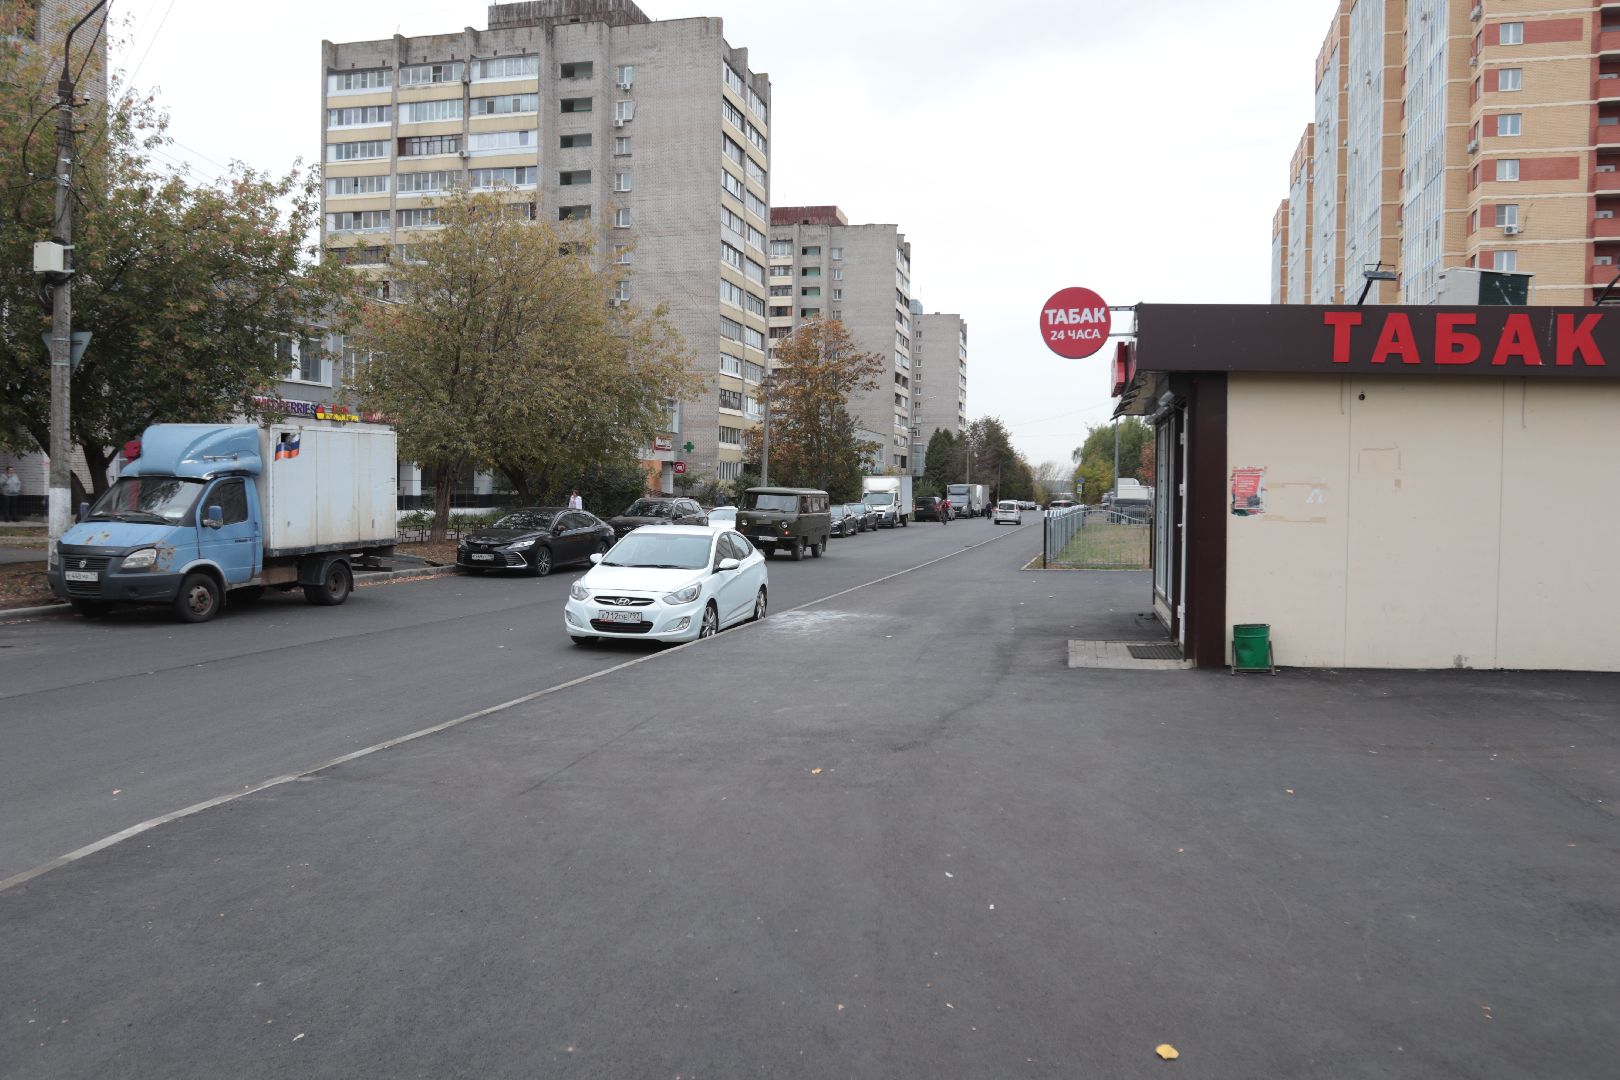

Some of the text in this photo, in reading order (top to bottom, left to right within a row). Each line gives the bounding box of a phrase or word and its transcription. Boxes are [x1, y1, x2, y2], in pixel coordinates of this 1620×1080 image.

[1045, 307, 1106, 325] ТАБАК
[1050, 329, 1101, 340] 24 ЧАСА
[1324, 311, 1607, 366] ТАБАК
